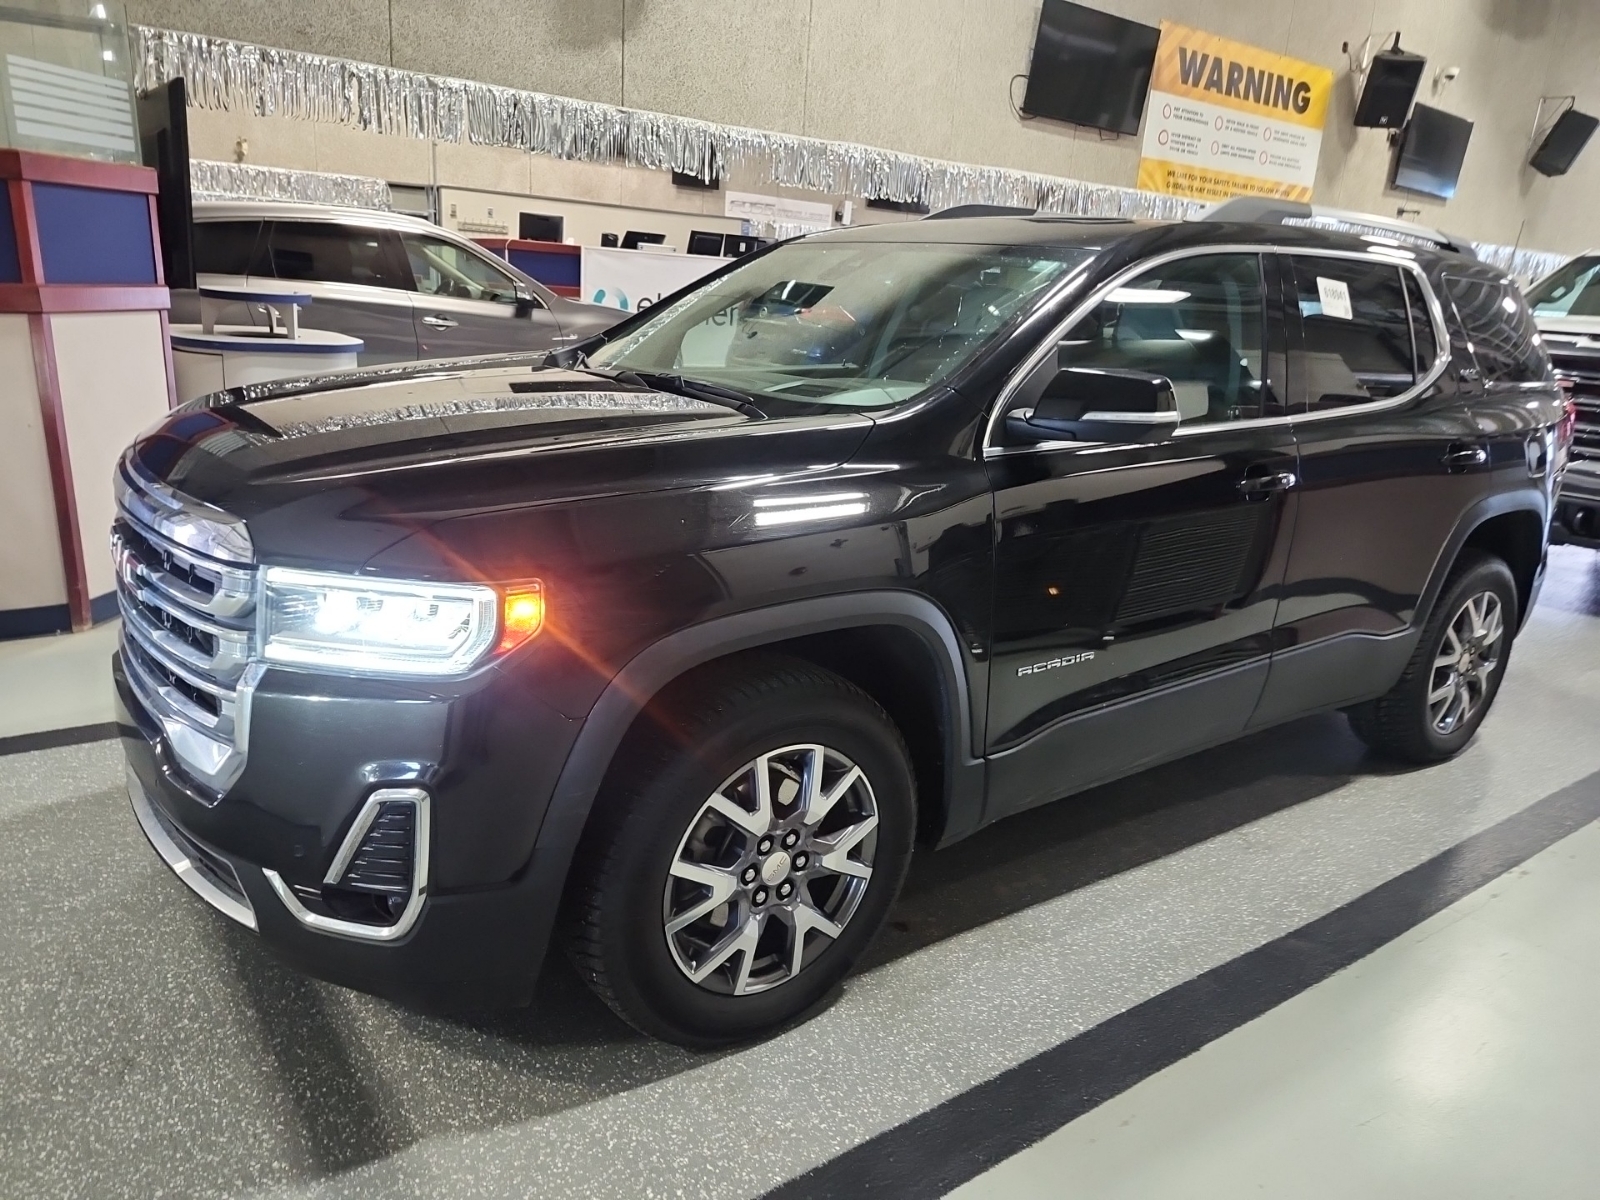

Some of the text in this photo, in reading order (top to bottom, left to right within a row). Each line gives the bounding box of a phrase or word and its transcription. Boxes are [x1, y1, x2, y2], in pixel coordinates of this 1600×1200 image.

[1179, 47, 1311, 115] WARNING
[1017, 651, 1095, 677] ACADIA
[766, 855, 787, 882] GMC
